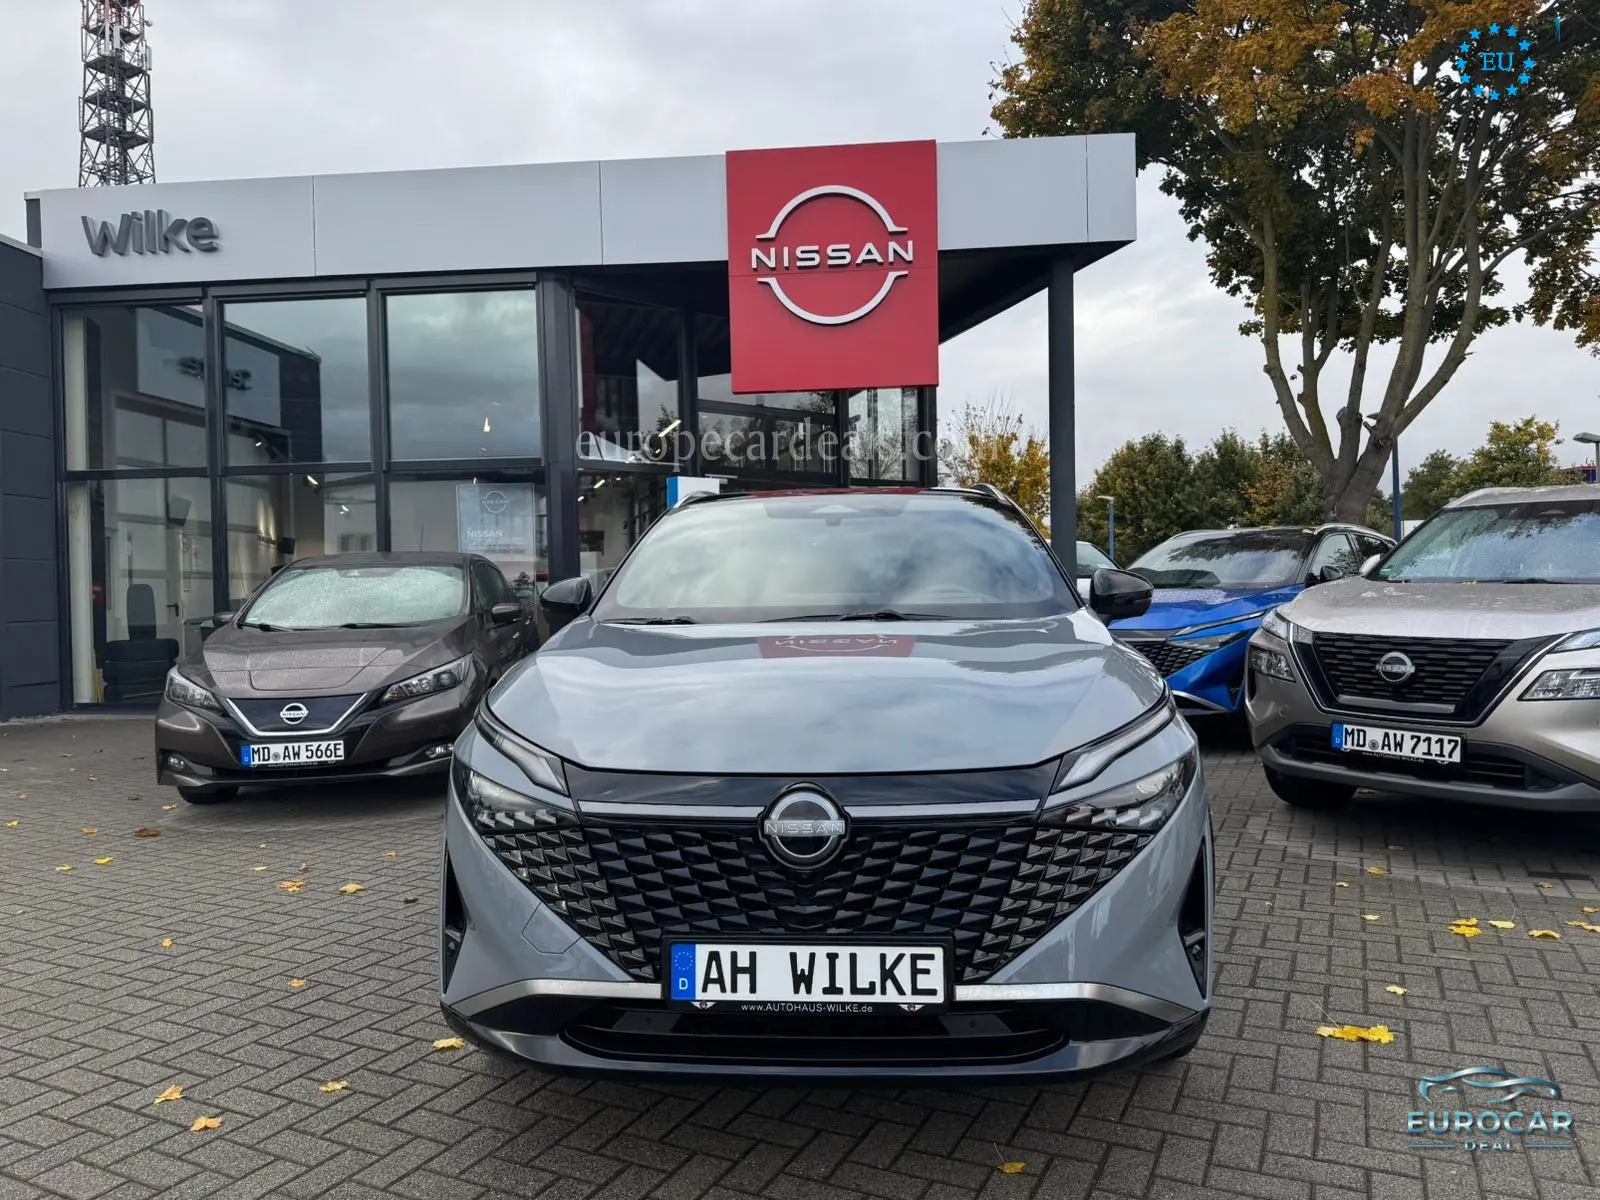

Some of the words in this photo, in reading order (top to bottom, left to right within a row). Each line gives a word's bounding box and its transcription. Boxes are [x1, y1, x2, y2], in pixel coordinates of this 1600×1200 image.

[751, 240, 914, 271] NISSAN
[466, 529, 503, 538] NISSAN
[1344, 727, 1367, 748] MD
[1381, 732, 1404, 753] AW
[1410, 735, 1459, 759] 7117
[251, 746, 271, 762] MD
[283, 745, 301, 760] AW
[305, 743, 343, 760] 566E
[766, 823, 844, 834] NISSAN
[701, 951, 757, 994] AH
[789, 952, 938, 997] WILKE
[679, 978, 688, 990] D
[741, 1003, 873, 1013] www.AUTOHAUS-WILKE.de
